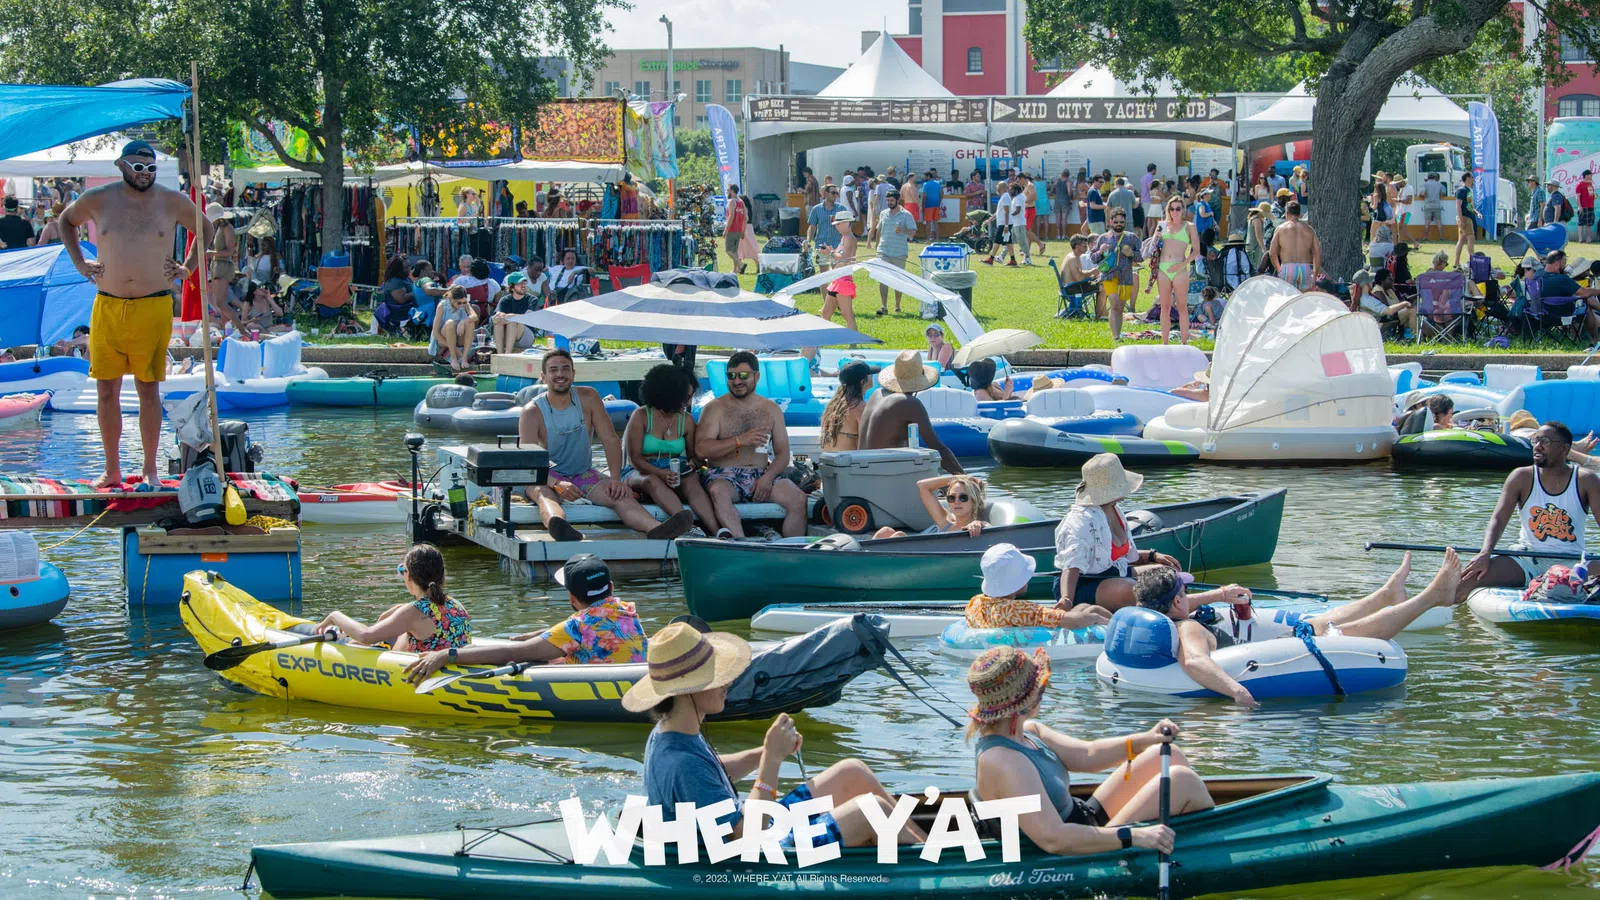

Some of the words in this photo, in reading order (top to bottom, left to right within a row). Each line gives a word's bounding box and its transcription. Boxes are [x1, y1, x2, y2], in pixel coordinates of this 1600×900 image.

[1018, 102, 1048, 119] MID
[1056, 102, 1094, 119] CITY
[1103, 102, 1158, 119] YACHT
[991, 149, 1030, 159] BER
[431, 388, 465, 398] Academy
[206, 485, 217, 493] 10
[277, 653, 392, 687] EXPLORER
[989, 871, 1025, 888] Old
[1028, 867, 1075, 885] Town
